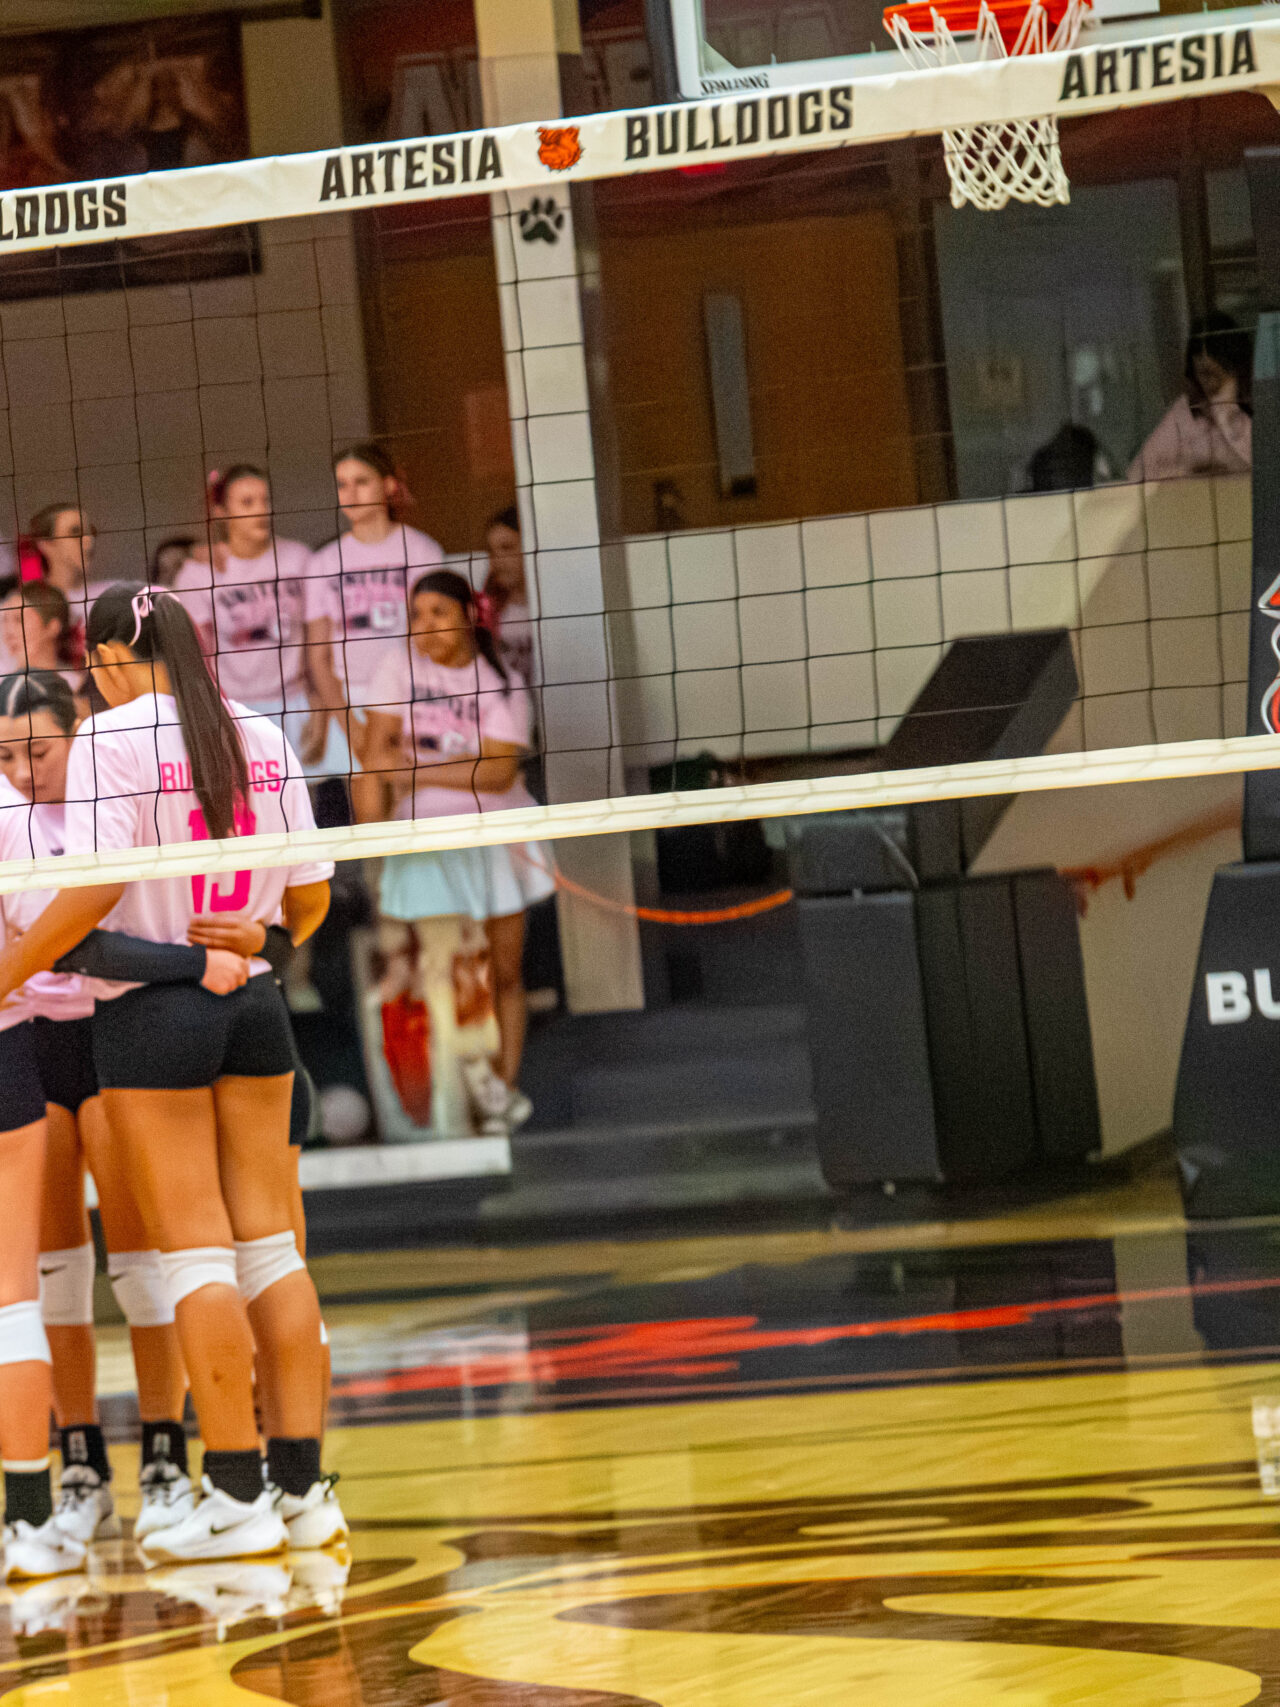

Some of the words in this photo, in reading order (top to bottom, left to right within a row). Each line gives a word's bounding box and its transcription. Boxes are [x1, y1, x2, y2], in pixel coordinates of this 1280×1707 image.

[1059, 29, 1257, 101] ARTESIA
[319, 137, 503, 202] ARTESIA
[625, 86, 853, 161] BULLDOGS
[1205, 968, 1280, 1025] BU
